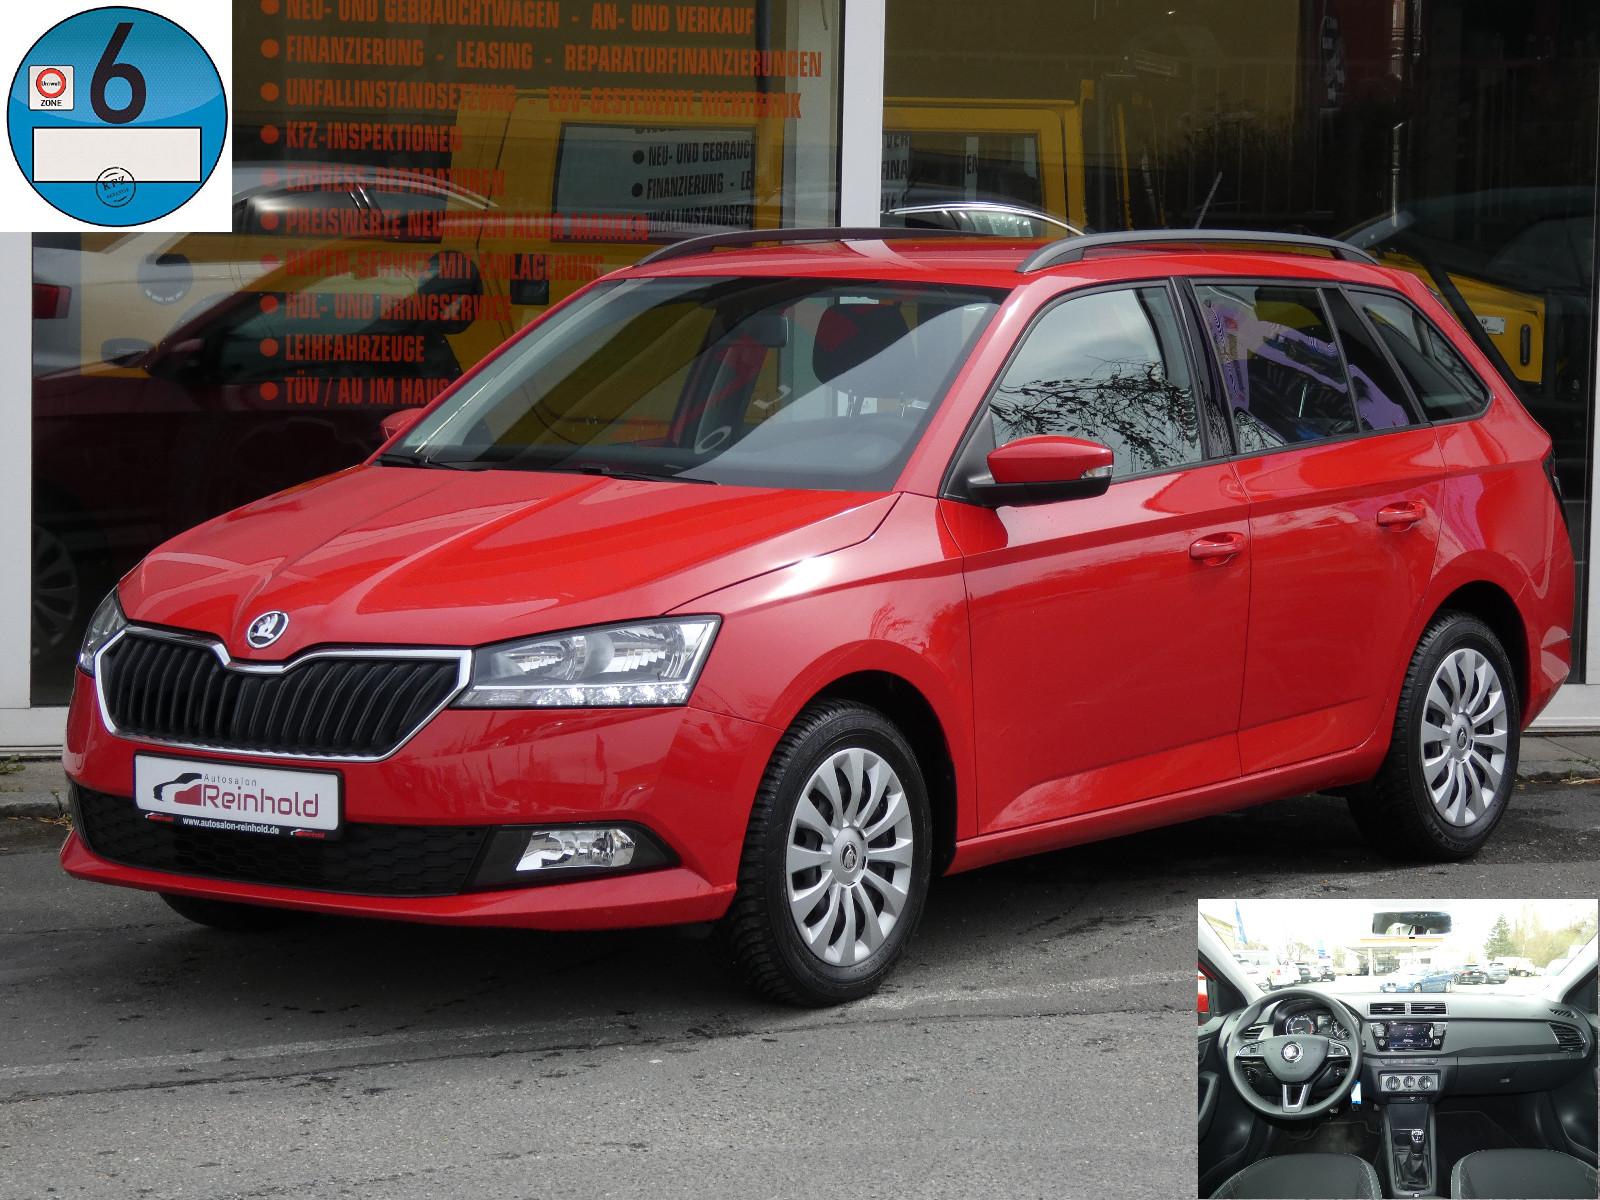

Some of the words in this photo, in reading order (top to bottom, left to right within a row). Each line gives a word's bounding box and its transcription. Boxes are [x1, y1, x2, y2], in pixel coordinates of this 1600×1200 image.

[286, 0, 332, 20] NEU-
[338, 0, 378, 22] UND
[385, 0, 560, 28] GEBRAUCHTWAGEN
[591, 3, 625, 30] AN-
[632, 5, 669, 32] UND
[676, 7, 755, 34] VERKAUF
[286, 35, 424, 67] FINANZIERUNG
[456, 40, 534, 70] LEASING
[564, 44, 822, 78] REPARATURFINANZIERUNGEN
[286, 79, 516, 111] UNFALLINSTANDSETZUNG
[548, 87, 696, 117] EDV-GESTEUERTE
[701, 90, 802, 119] RICHTBANK
[286, 121, 463, 152] KFZ-INSPEKTIONEN
[647, 172, 724, 200] FINANZIERUNG
[286, 208, 402, 237] PREISWERTE
[439, 250, 473, 281] MIT
[286, 293, 329, 320] HOL-
[335, 293, 373, 321] UND
[380, 294, 512, 322] BRINGSERVICE
[285, 334, 425, 363] LEIHFAHRZEUGE
[284, 371, 319, 405] TÜV
[336, 378, 363, 404] AU
[369, 378, 396, 406] IM
[203, 774, 257, 787] Autosalon
[203, 784, 319, 818] Reinhold
[182, 817, 280, 835] www.autosalon-reinhold.de
